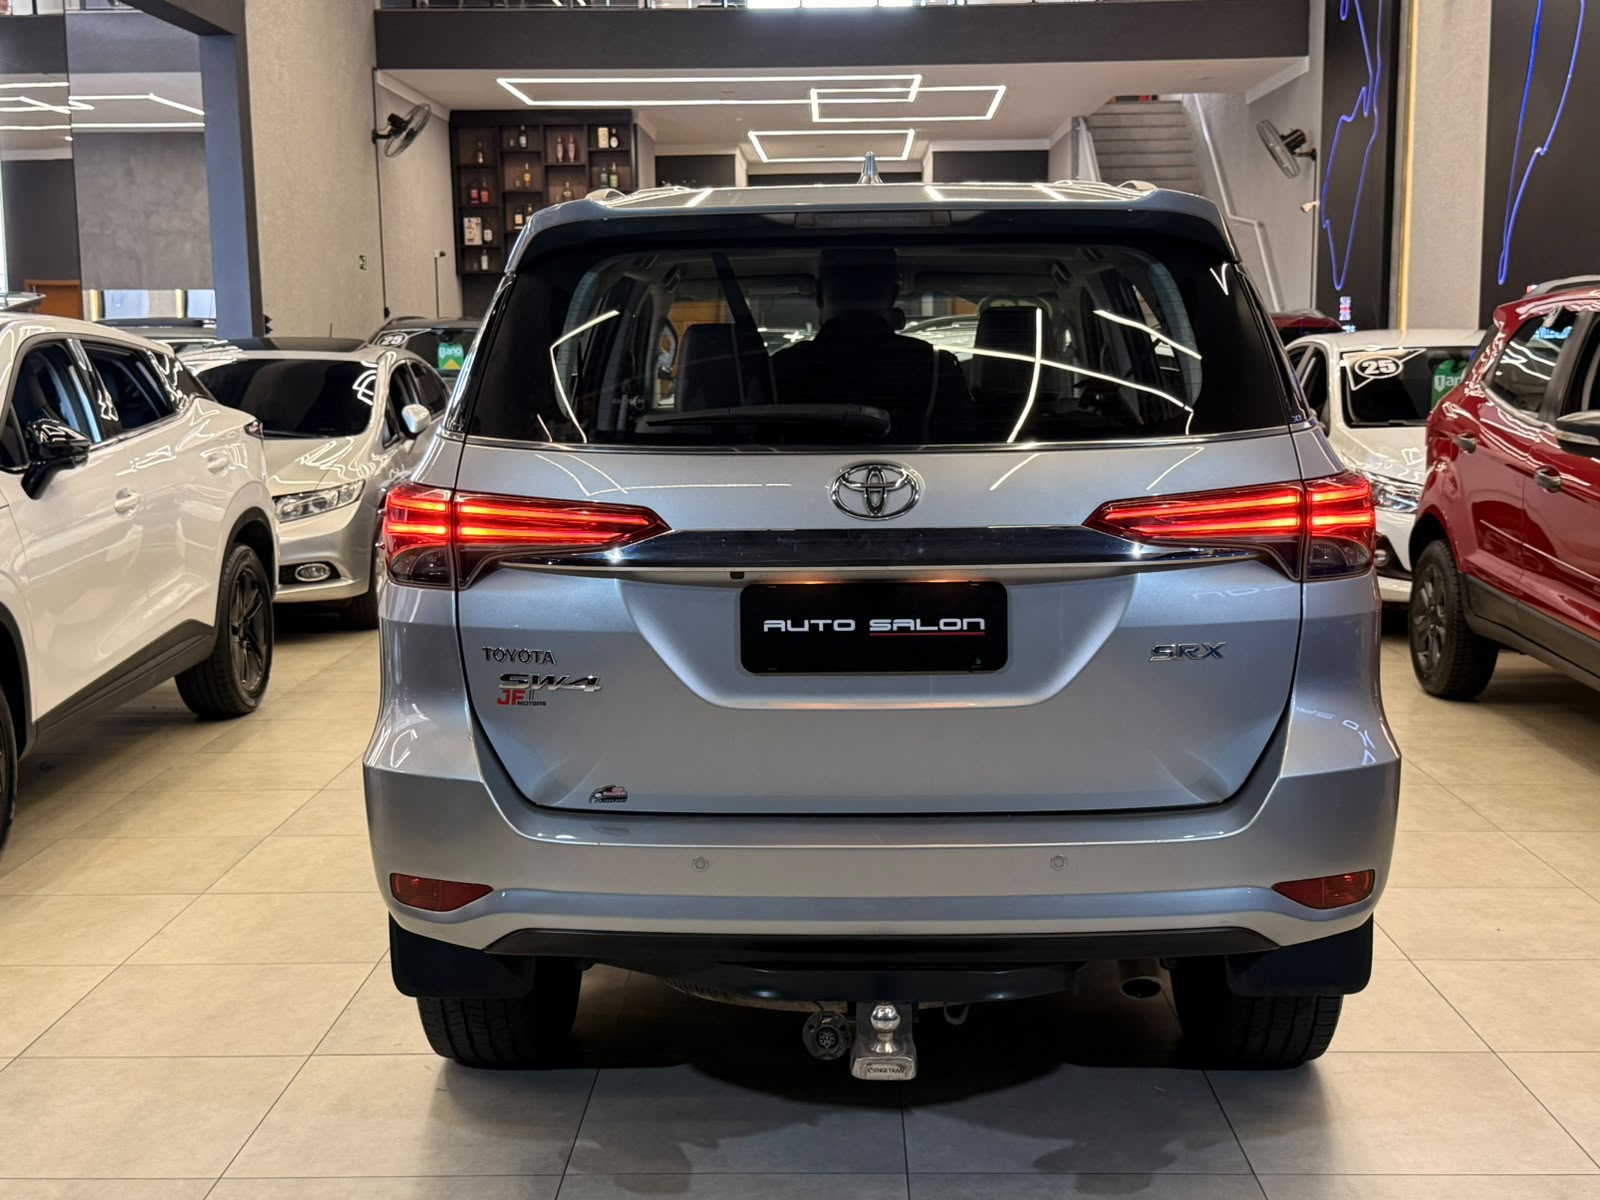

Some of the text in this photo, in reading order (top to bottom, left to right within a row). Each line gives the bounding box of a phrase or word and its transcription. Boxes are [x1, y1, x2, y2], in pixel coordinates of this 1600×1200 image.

[1362, 360, 1397, 374] 25
[763, 618, 986, 632] AUTO SALON
[482, 646, 557, 665] TOYOTA
[1149, 641, 1227, 662] SRX
[499, 673, 601, 692] SW4
[497, 689, 526, 706] JF
